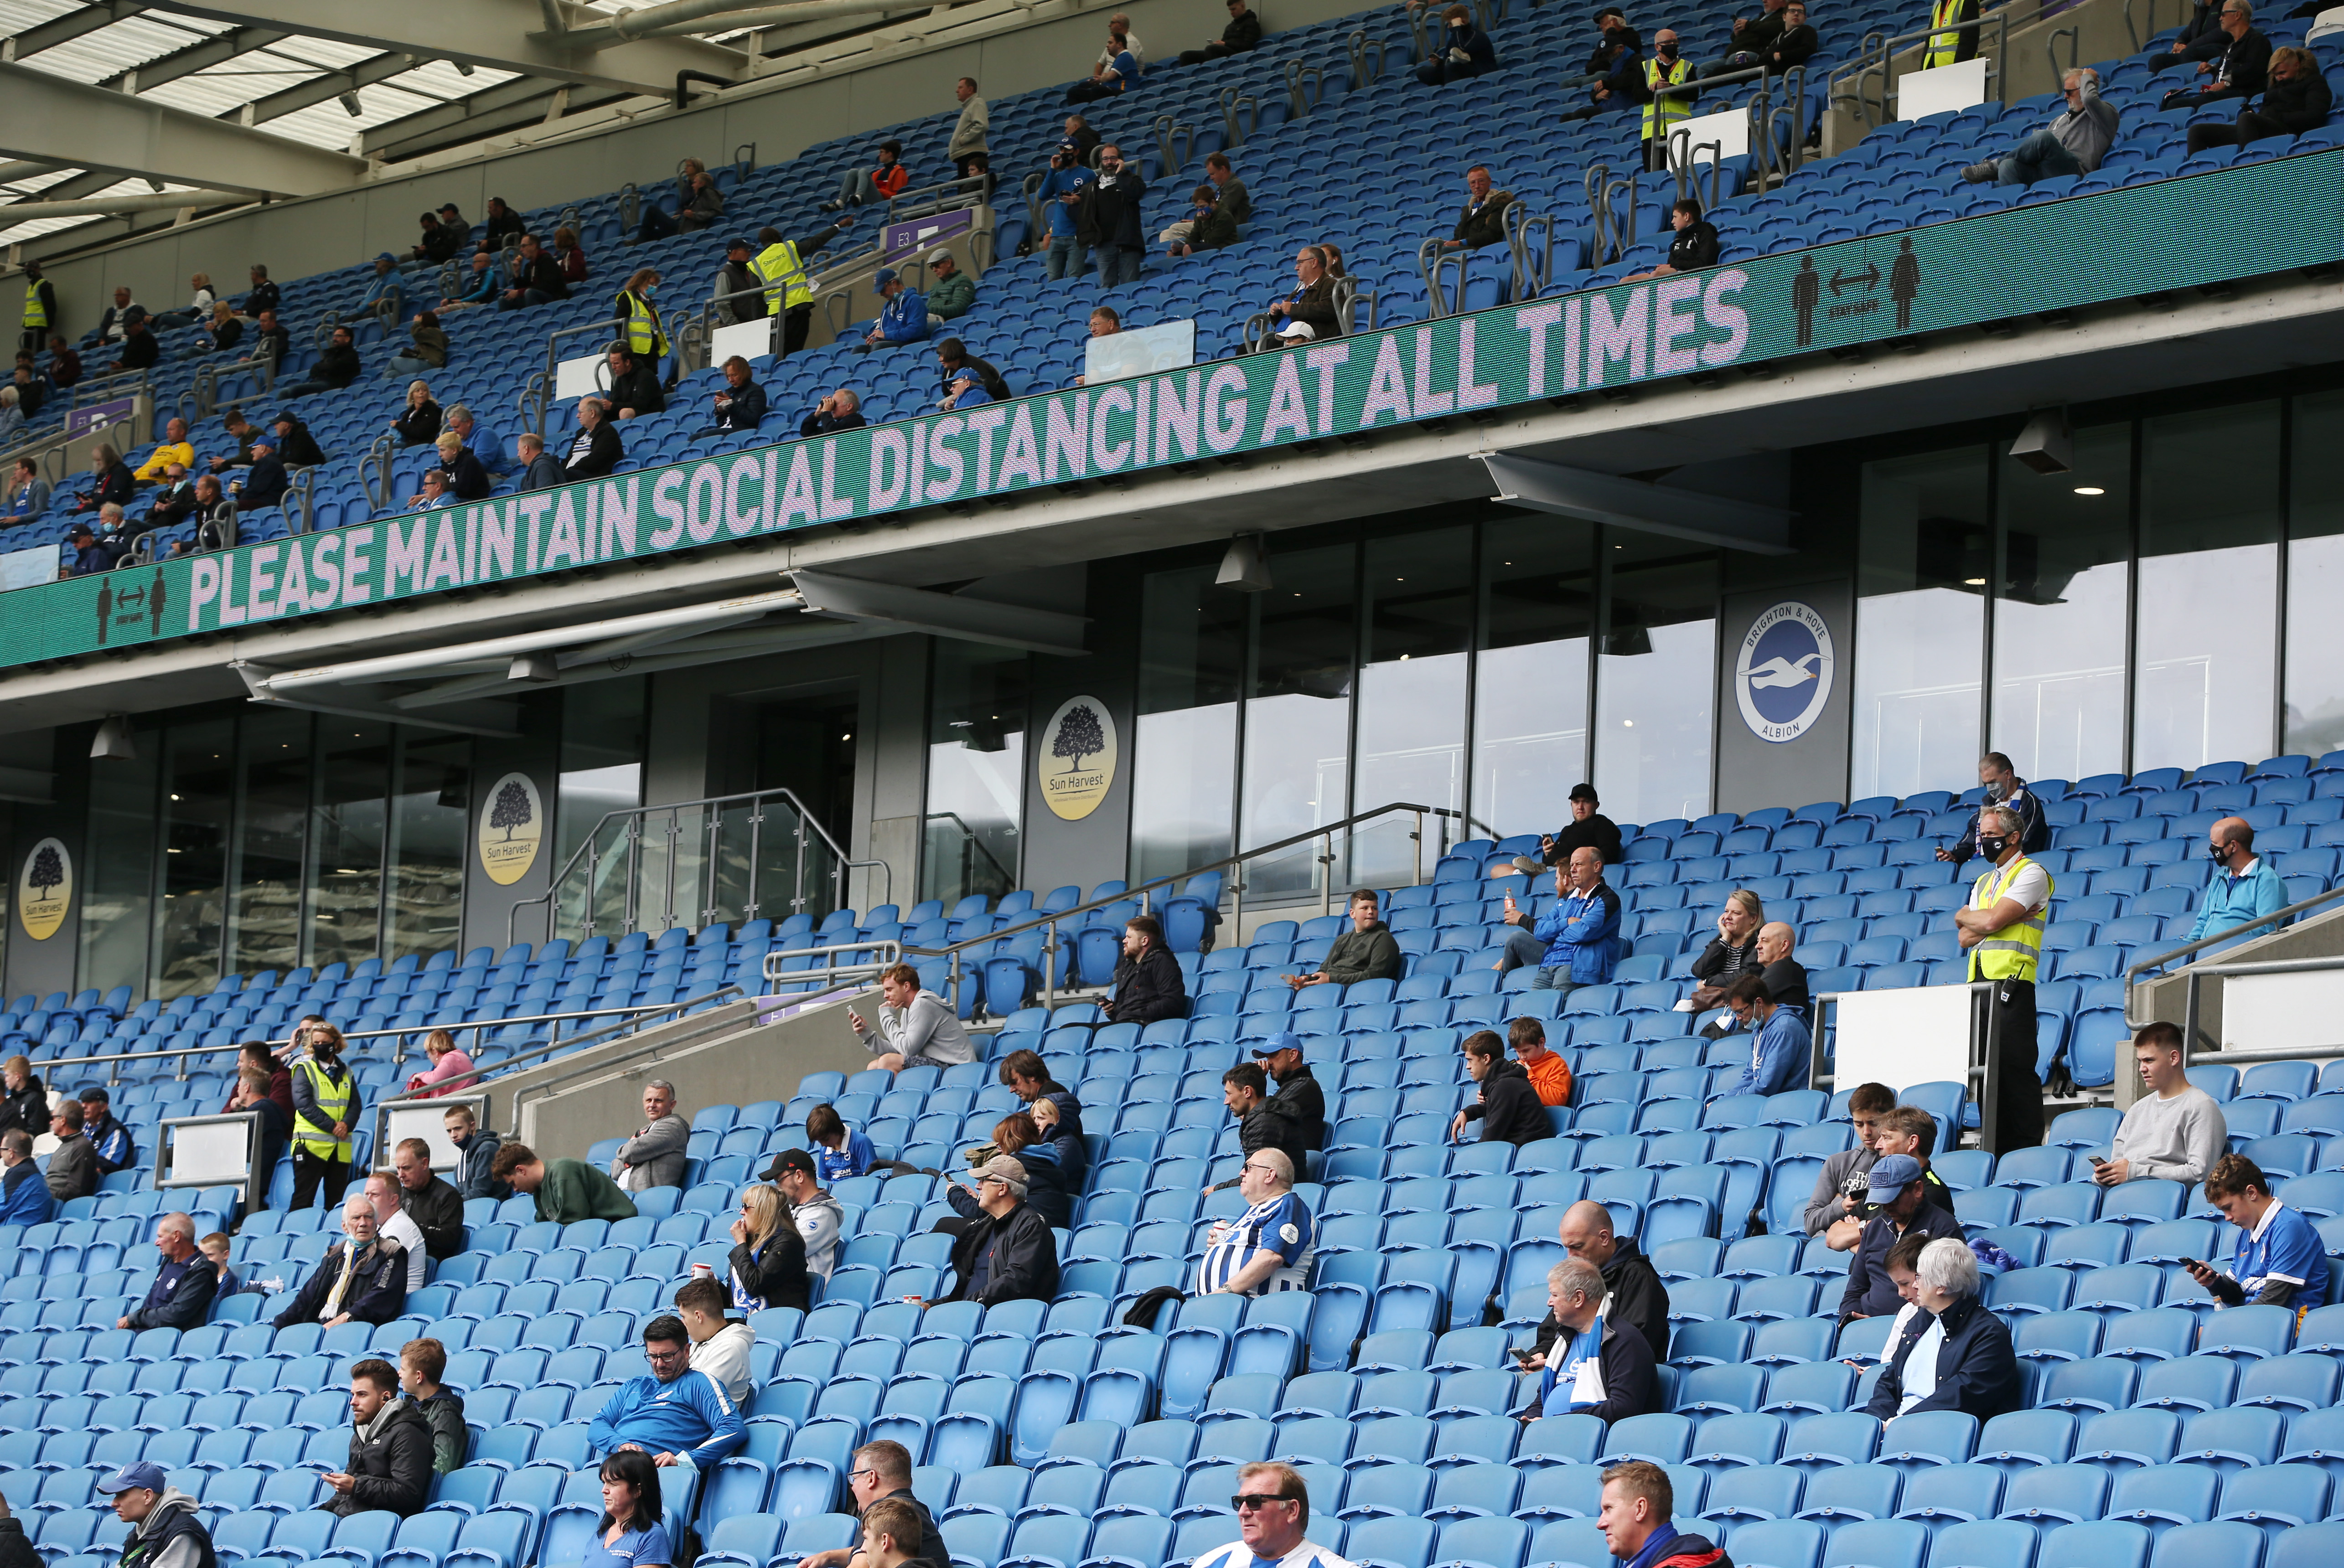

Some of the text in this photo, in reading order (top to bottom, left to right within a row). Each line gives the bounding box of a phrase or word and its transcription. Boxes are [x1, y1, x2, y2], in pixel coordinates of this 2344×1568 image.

[898, 232, 910, 247] E3
[763, 252, 786, 267] Steward
[189, 269, 1749, 630] PLEASE MAINTAIN SOCIAL DISTANCING AT ALL TIMES
[1747, 606, 1826, 647] BRIGHTON & HOVE
[1762, 722, 1800, 738] ALBION
[1050, 773, 1103, 790] Sun Harvest
[487, 842, 531, 859] Sun Harvest
[26, 903, 62, 915] Sun Harvest
[1855, 1171, 1870, 1181] TH
